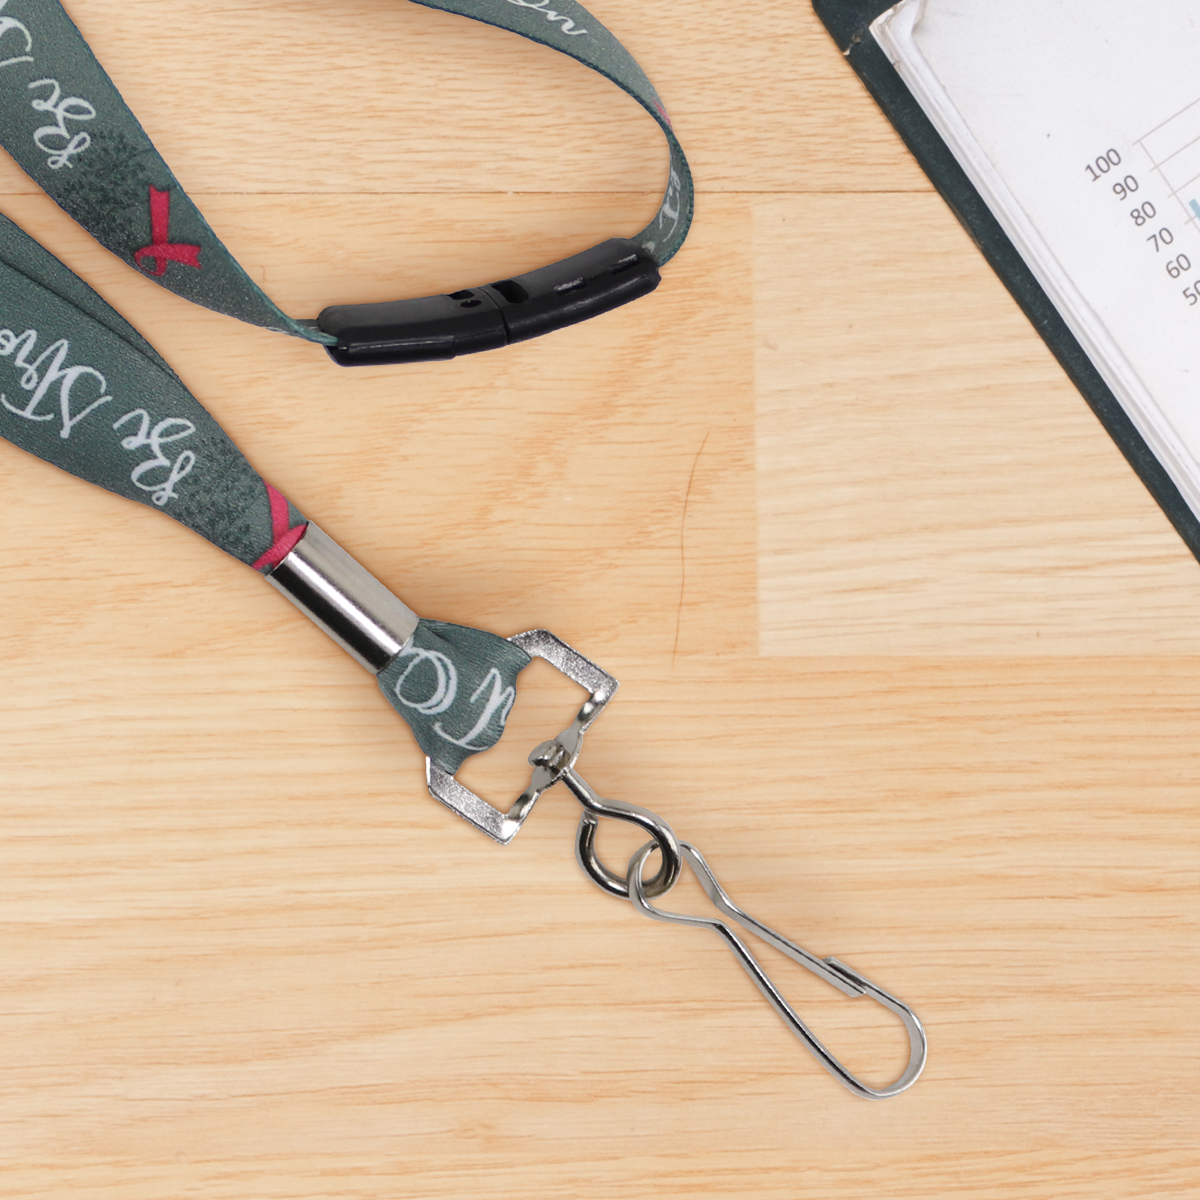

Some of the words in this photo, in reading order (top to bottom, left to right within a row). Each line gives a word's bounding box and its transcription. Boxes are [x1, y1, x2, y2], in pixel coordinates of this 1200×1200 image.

[28, 78, 96, 169] Be
[1084, 147, 1122, 182] 100
[1111, 174, 1140, 201] 90
[1129, 200, 1157, 227] 80
[1146, 226, 1174, 253] 70
[1165, 252, 1192, 279] 60
[112, 408, 196, 506] Be
